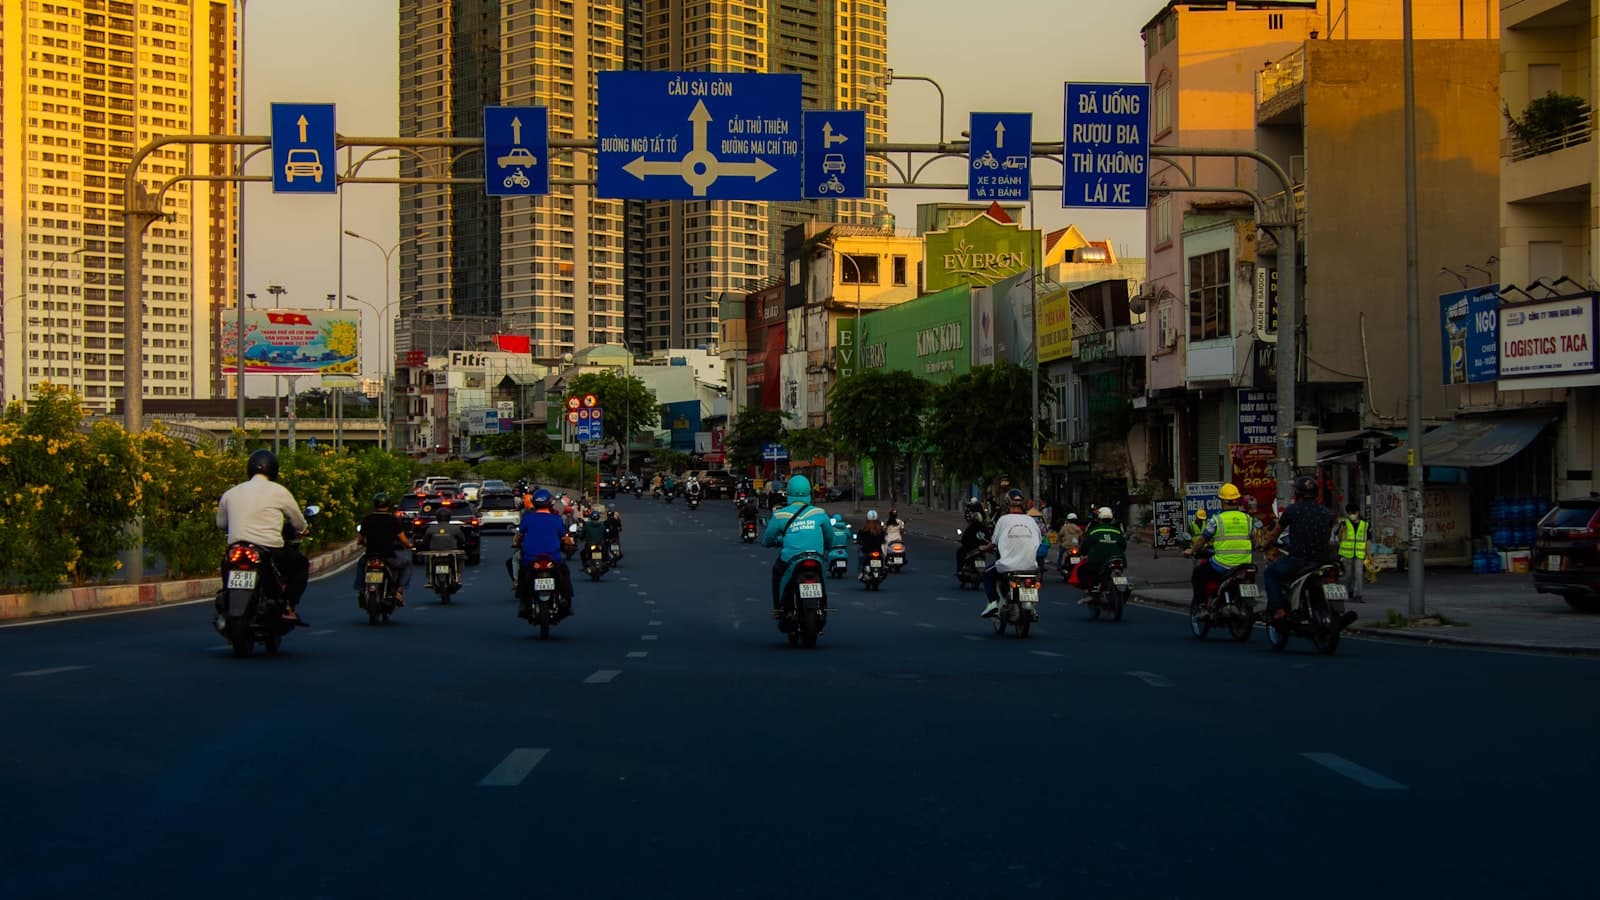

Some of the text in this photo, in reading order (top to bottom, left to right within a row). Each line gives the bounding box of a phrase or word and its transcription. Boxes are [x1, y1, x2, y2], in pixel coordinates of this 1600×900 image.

[668, 76, 733, 97] CẦU SÀI GÒN
[1079, 88, 1140, 115] ĐÃ UỐNG
[728, 114, 788, 134] CẦU THỦ THIÊM
[601, 133, 679, 153] ĐƯỜNG NGÔ TẤT TỐ
[1072, 123, 1140, 147] RƯỢU BIA
[721, 137, 798, 157] ĐƯỜNG MAI CHÍ THỌ
[1071, 149, 1144, 174] THÌ KHÔNG
[977, 174, 1022, 185] XE 2 BÁNH
[1084, 177, 1131, 203] LÁI XE
[976, 186, 1021, 197] VÀ 3 BÁNH
[943, 251, 1024, 269] EVERON
[916, 327, 939, 357] KING
[940, 322, 964, 352] KOIL
[1504, 333, 1588, 358] LOGISTICS TACA
